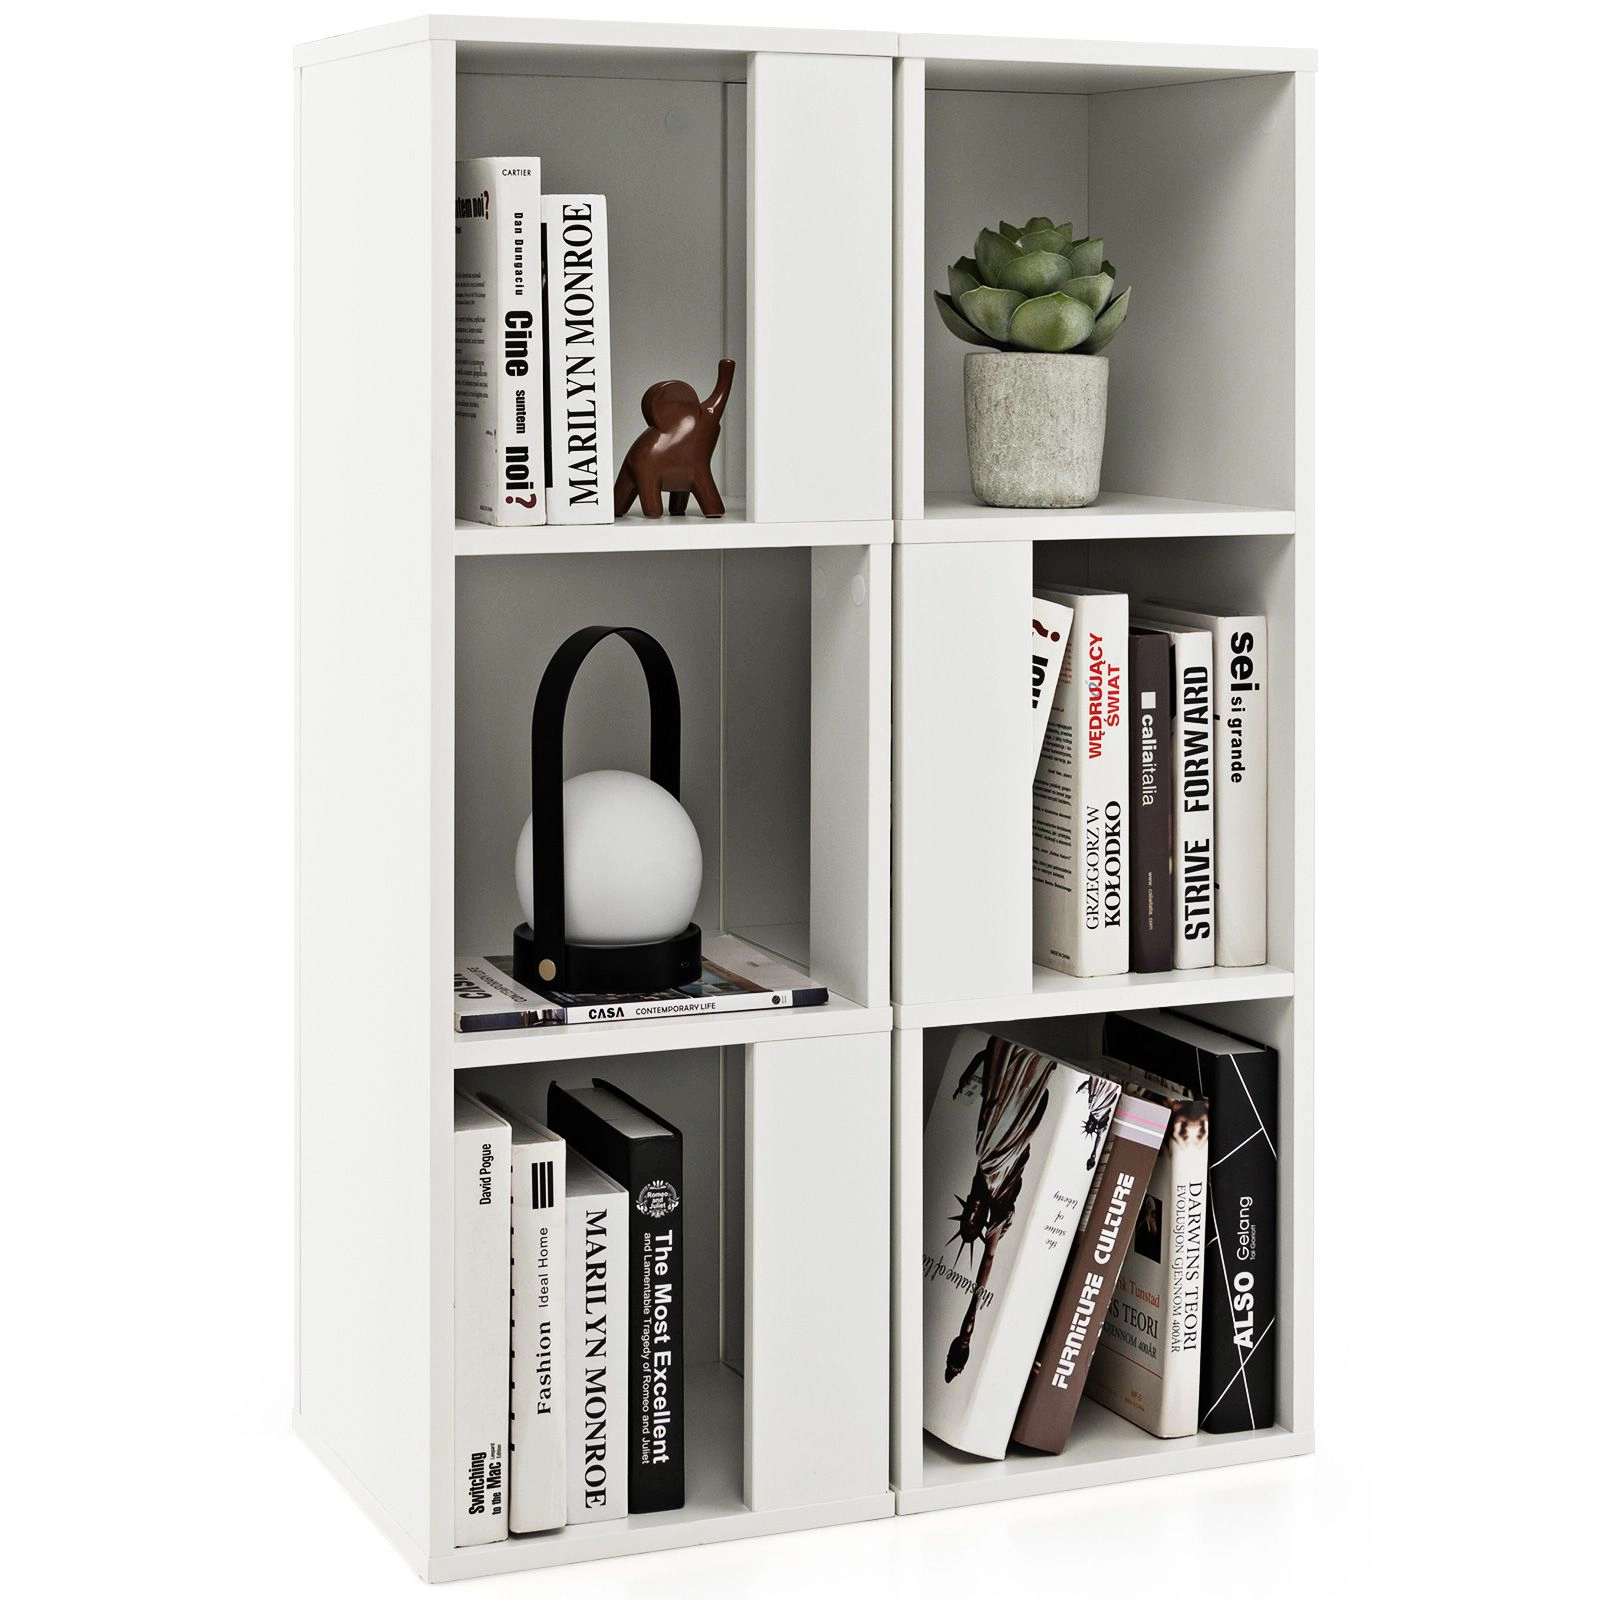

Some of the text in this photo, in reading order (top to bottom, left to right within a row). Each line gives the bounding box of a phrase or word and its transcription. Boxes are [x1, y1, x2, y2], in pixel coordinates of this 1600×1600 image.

[502, 169, 532, 177] CARTIER
[514, 212, 525, 295] Dan Dungaciu
[505, 310, 537, 509] Cine suntem noi?
[562, 202, 599, 507] MARILYN MONROE
[1088, 632, 1106, 760] WĘDRUJĄCY
[1104, 663, 1121, 727] ŚWIAT
[1227, 631, 1260, 784] sei si grande
[1141, 713, 1157, 806] caliaitalia
[1183, 666, 1211, 940] STRIVE FORWARD
[1086, 806, 1100, 930] GRZEGORZ W
[1104, 800, 1122, 929] KOŁODKO
[588, 1002, 716, 1020] CASA CONTEMPORARY LIFE
[479, 1143, 494, 1205] David Pogue
[535, 1226, 552, 1415] Fashion Ideal Home
[946, 1268, 978, 1295] statue
[1051, 1172, 1135, 1390] FURNITURE CULTURE
[1122, 1302, 1159, 1339] TEORI
[1129, 1280, 1160, 1308] Tunstad
[1171, 1185, 1187, 1353] EVOLUSJON GJENNOM 400ÅR
[1183, 1182, 1202, 1351] DARWINS TEORI
[1233, 1196, 1255, 1349] ALSO Gelang
[584, 1208, 608, 1509] MARILYN MONROE
[640, 1232, 652, 1465] and Lamentable Tragedy of Romeo and Juliet
[652, 1229, 673, 1465] The Most Excellent
[468, 1451, 487, 1515] Switching
[486, 1461, 502, 1515] to the Mac
